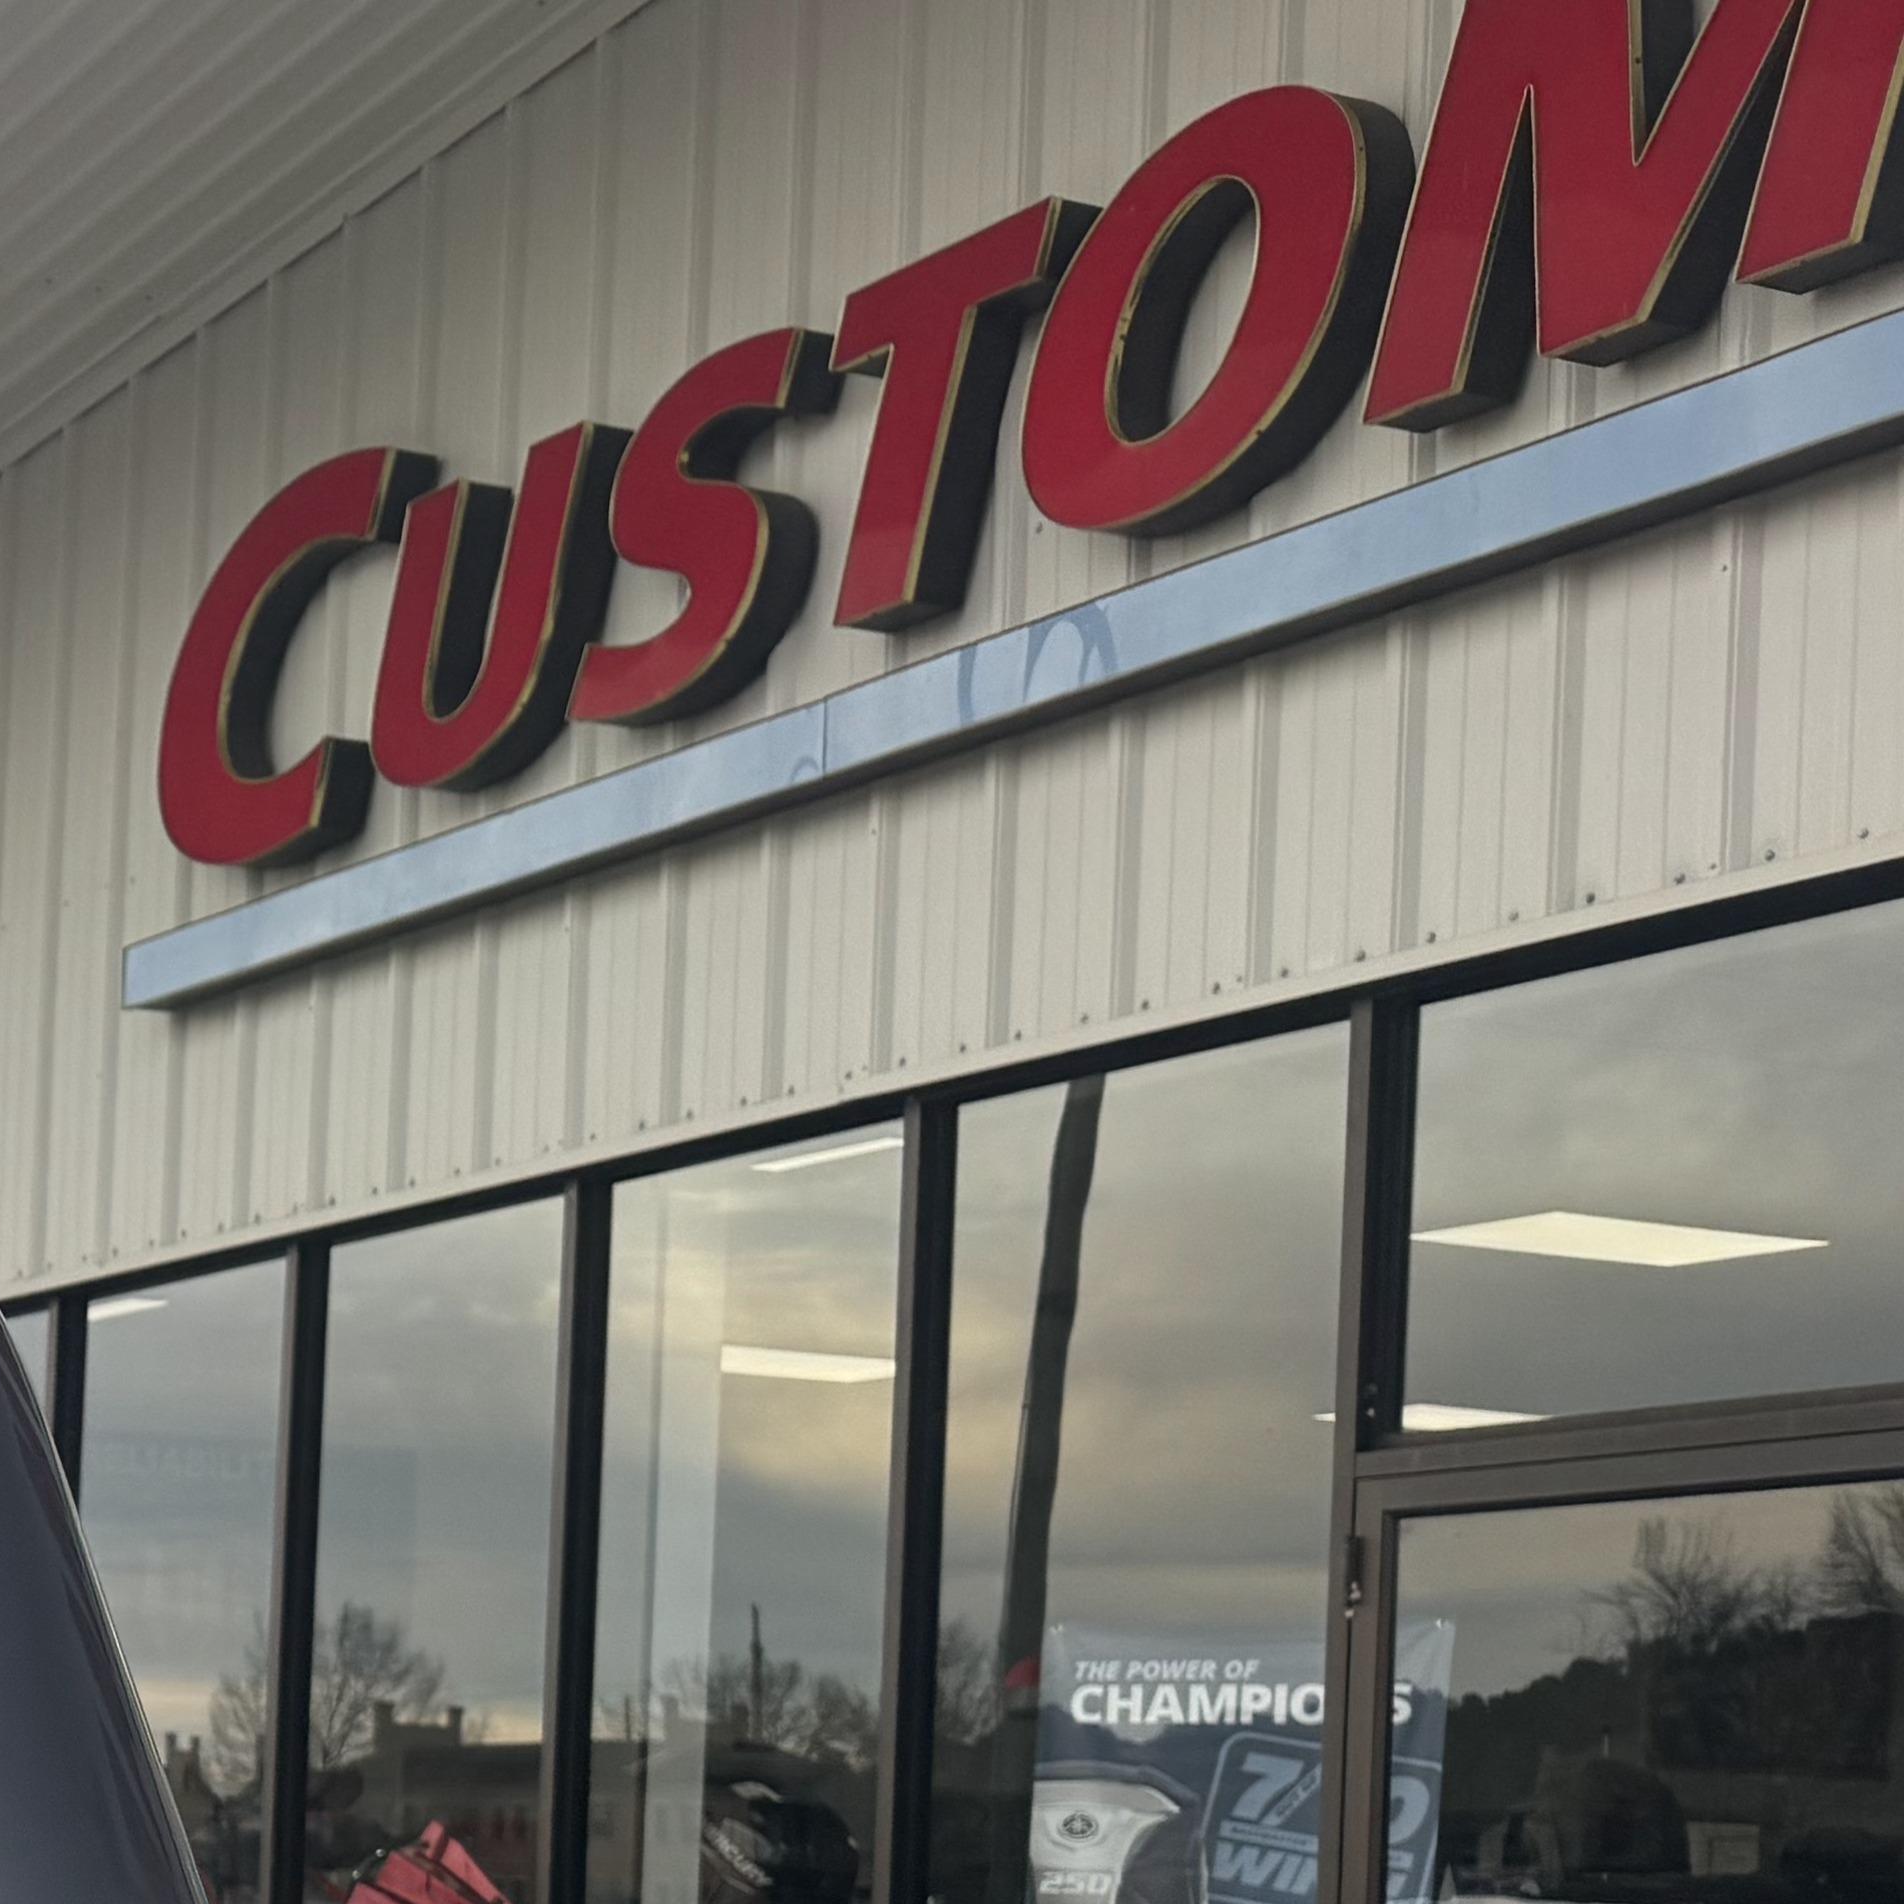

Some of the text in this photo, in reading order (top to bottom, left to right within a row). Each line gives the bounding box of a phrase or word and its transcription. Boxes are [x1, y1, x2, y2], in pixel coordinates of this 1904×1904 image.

[158, 0, 1904, 866] CUSTOM
[1075, 1659, 1260, 1682] THE POWER OF
[1070, 1683, 1413, 1726] CHAMPIOS
[1039, 1871, 1112, 1896] 250
